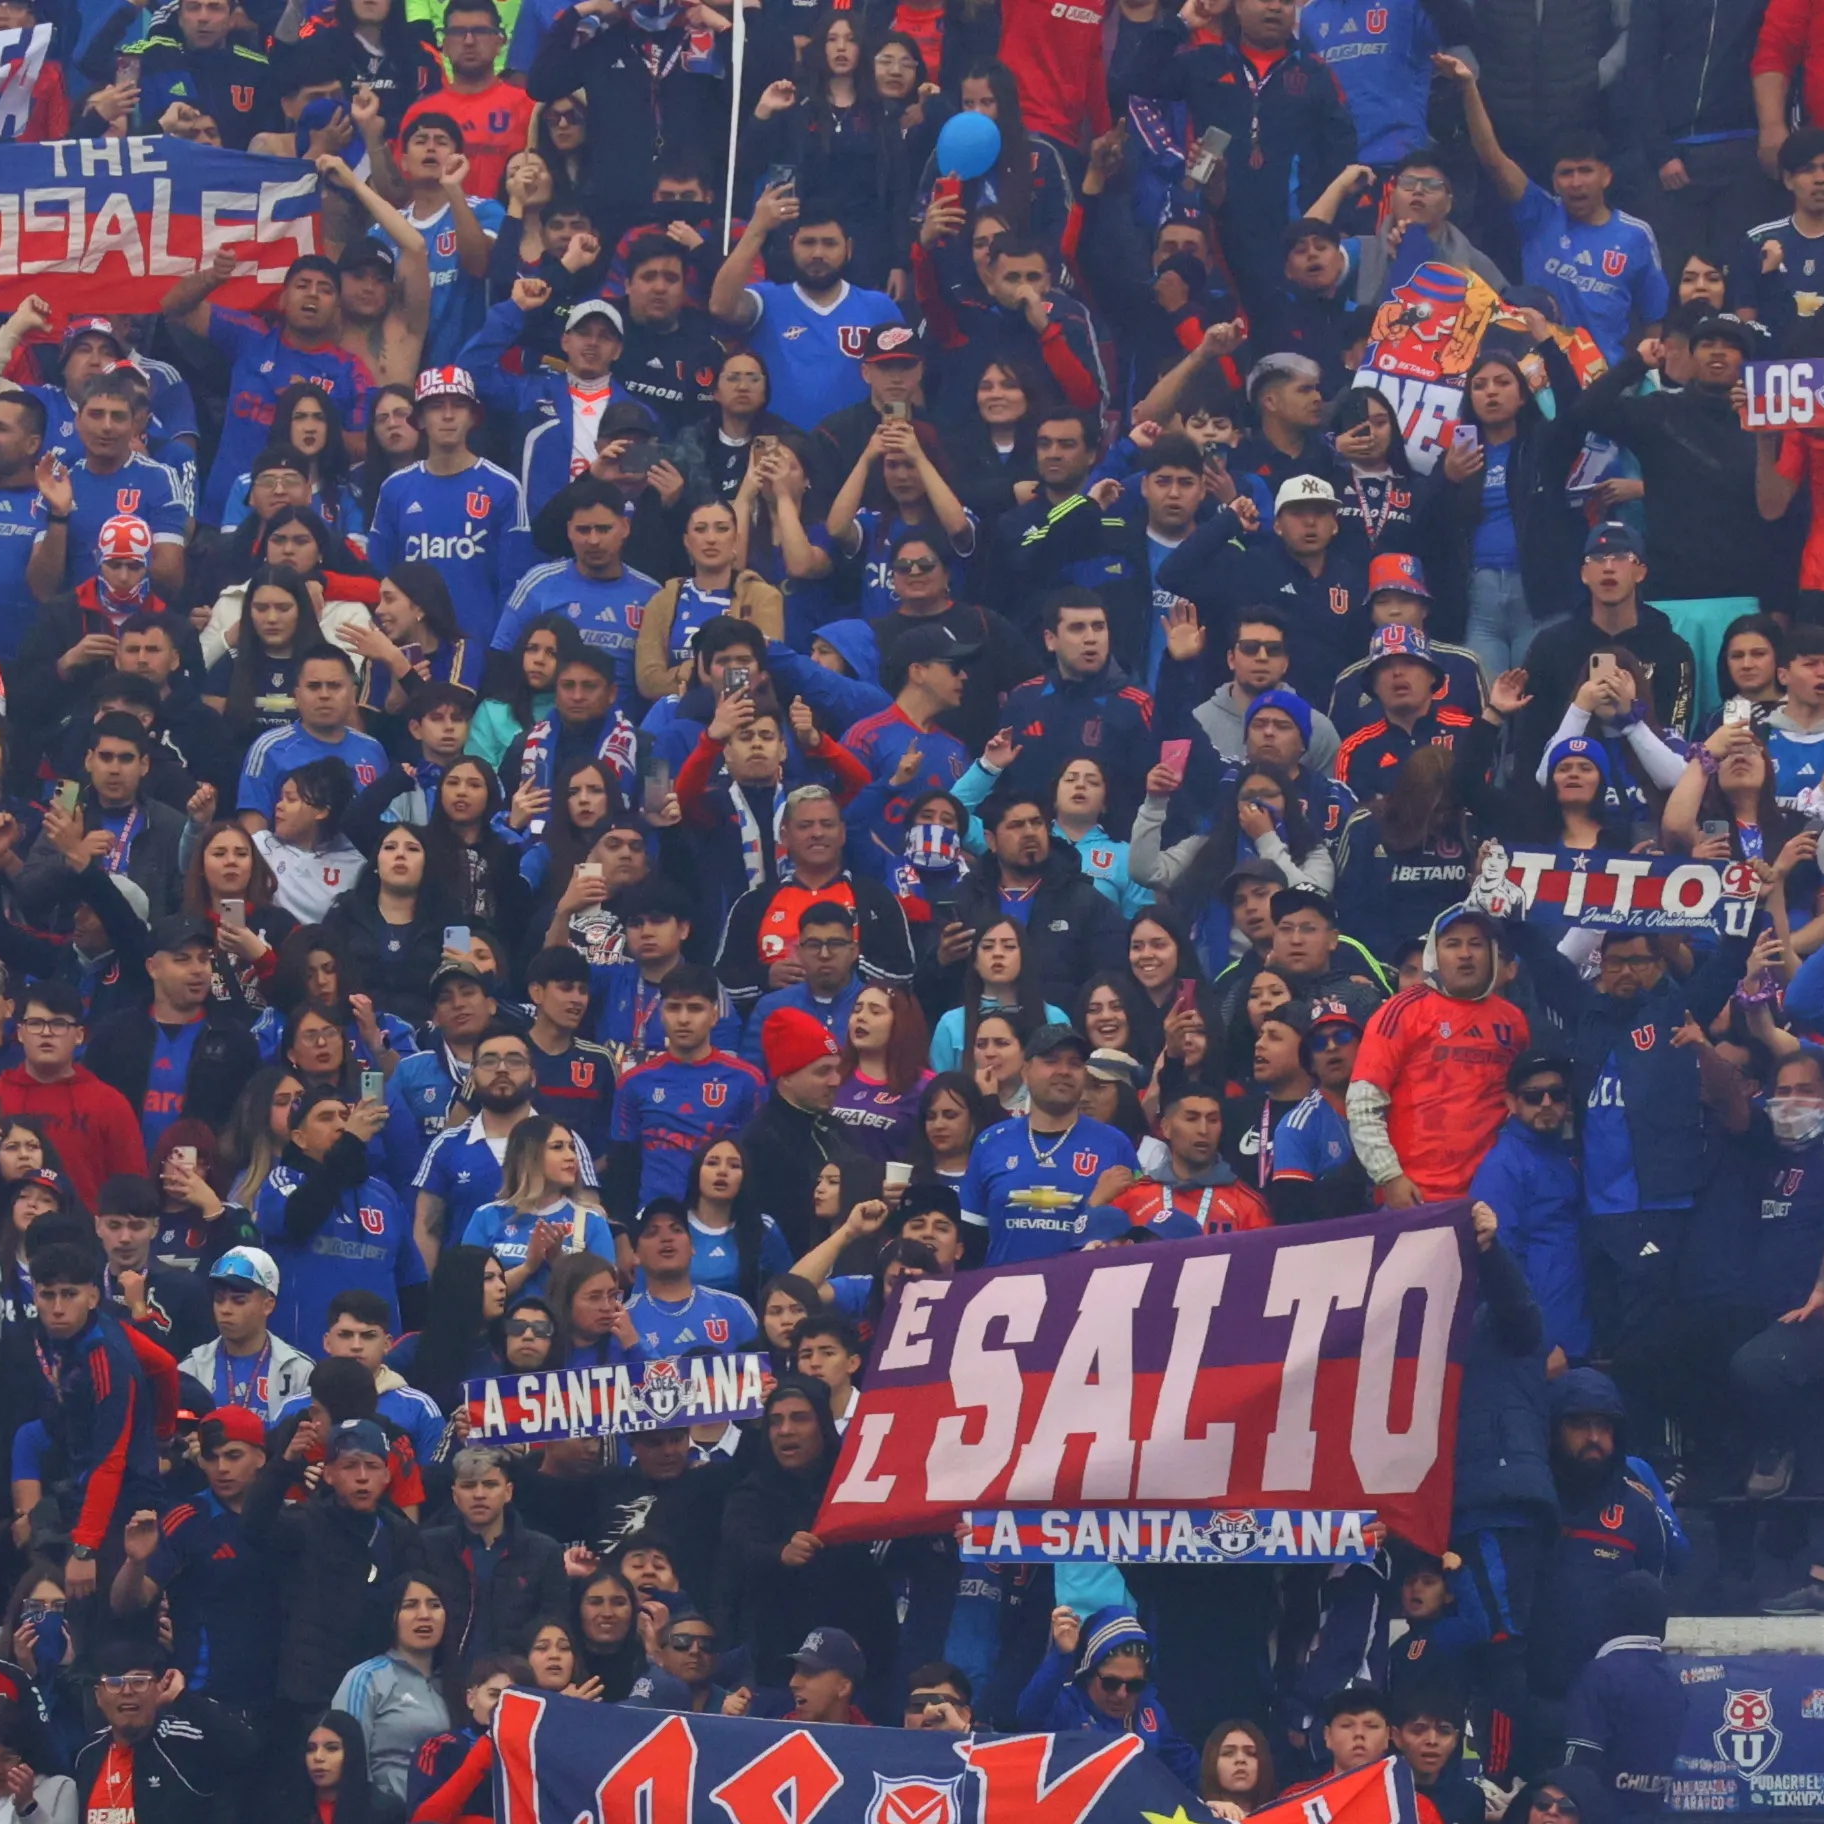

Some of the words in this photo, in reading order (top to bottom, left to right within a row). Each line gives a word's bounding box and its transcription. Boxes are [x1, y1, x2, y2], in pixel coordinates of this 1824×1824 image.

[40, 135, 167, 178] THE
[1746, 361, 1813, 425] LOS
[403, 529, 470, 563] claro
[1399, 866, 1466, 882] BETANO
[924, 1226, 1464, 1503] SALTO
[516, 1362, 632, 1433] SANTA
[686, 1352, 766, 1414] ANA
[596, 1417, 657, 1434] SALTO
[964, 1511, 1019, 1552] LA
[1041, 1511, 1193, 1553] SANTA
[1267, 1511, 1371, 1557] ANA
